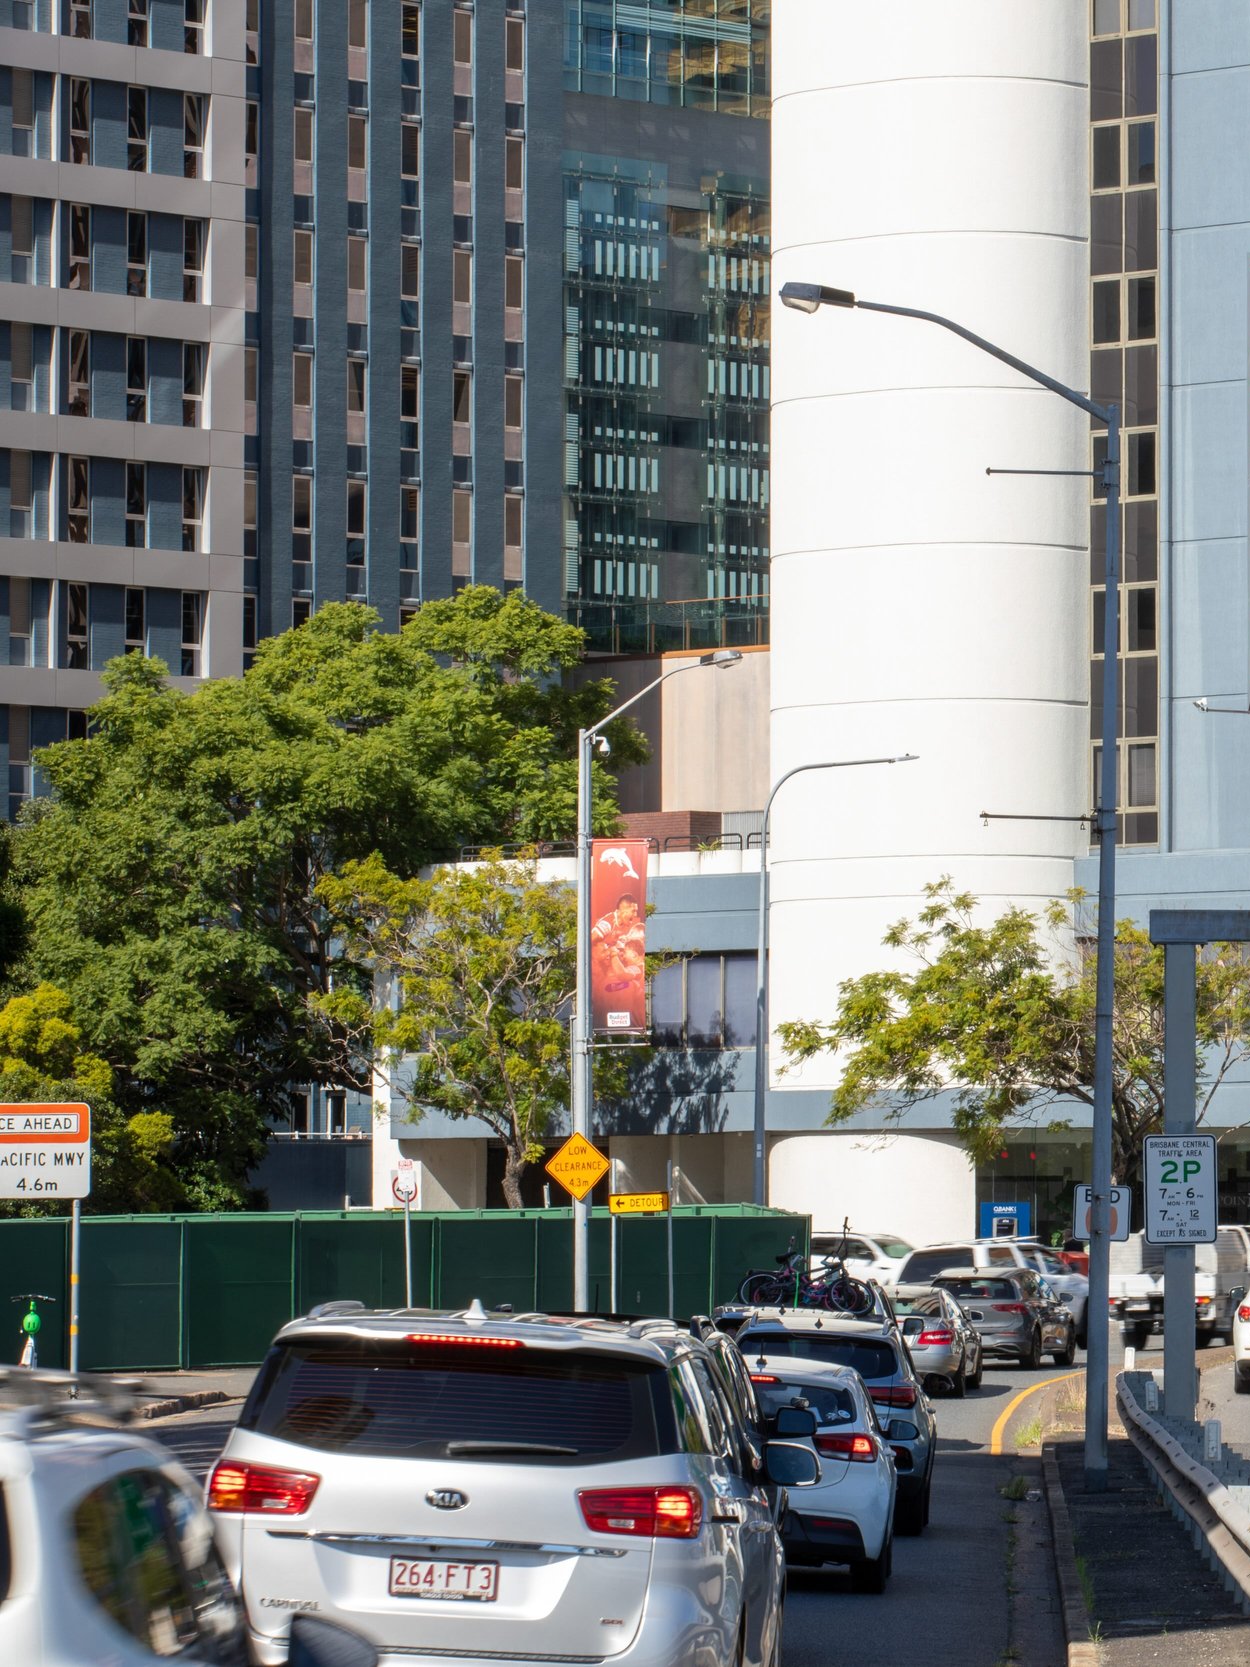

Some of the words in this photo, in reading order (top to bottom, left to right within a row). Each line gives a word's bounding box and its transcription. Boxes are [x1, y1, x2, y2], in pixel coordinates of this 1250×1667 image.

[24, 1117, 72, 1130] AHEAD
[1149, 1140, 1180, 1149] BRISBANE
[1182, 1140, 1210, 1148] CENTRAL
[568, 1146, 587, 1156] LOW
[1158, 1149, 1183, 1158] TRAFFIC
[1185, 1149, 1203, 1158] AREA
[54, 1152, 84, 1167] MWY
[554, 1161, 602, 1172] CLEARANCE
[16, 1177, 58, 1191] 4.6m
[629, 1197, 664, 1208] DETOUR
[1156, 1229, 1176, 1238] EXCEPT
[1188, 1229, 1207, 1237] SIGNED
[432, 1492, 463, 1506] KIA
